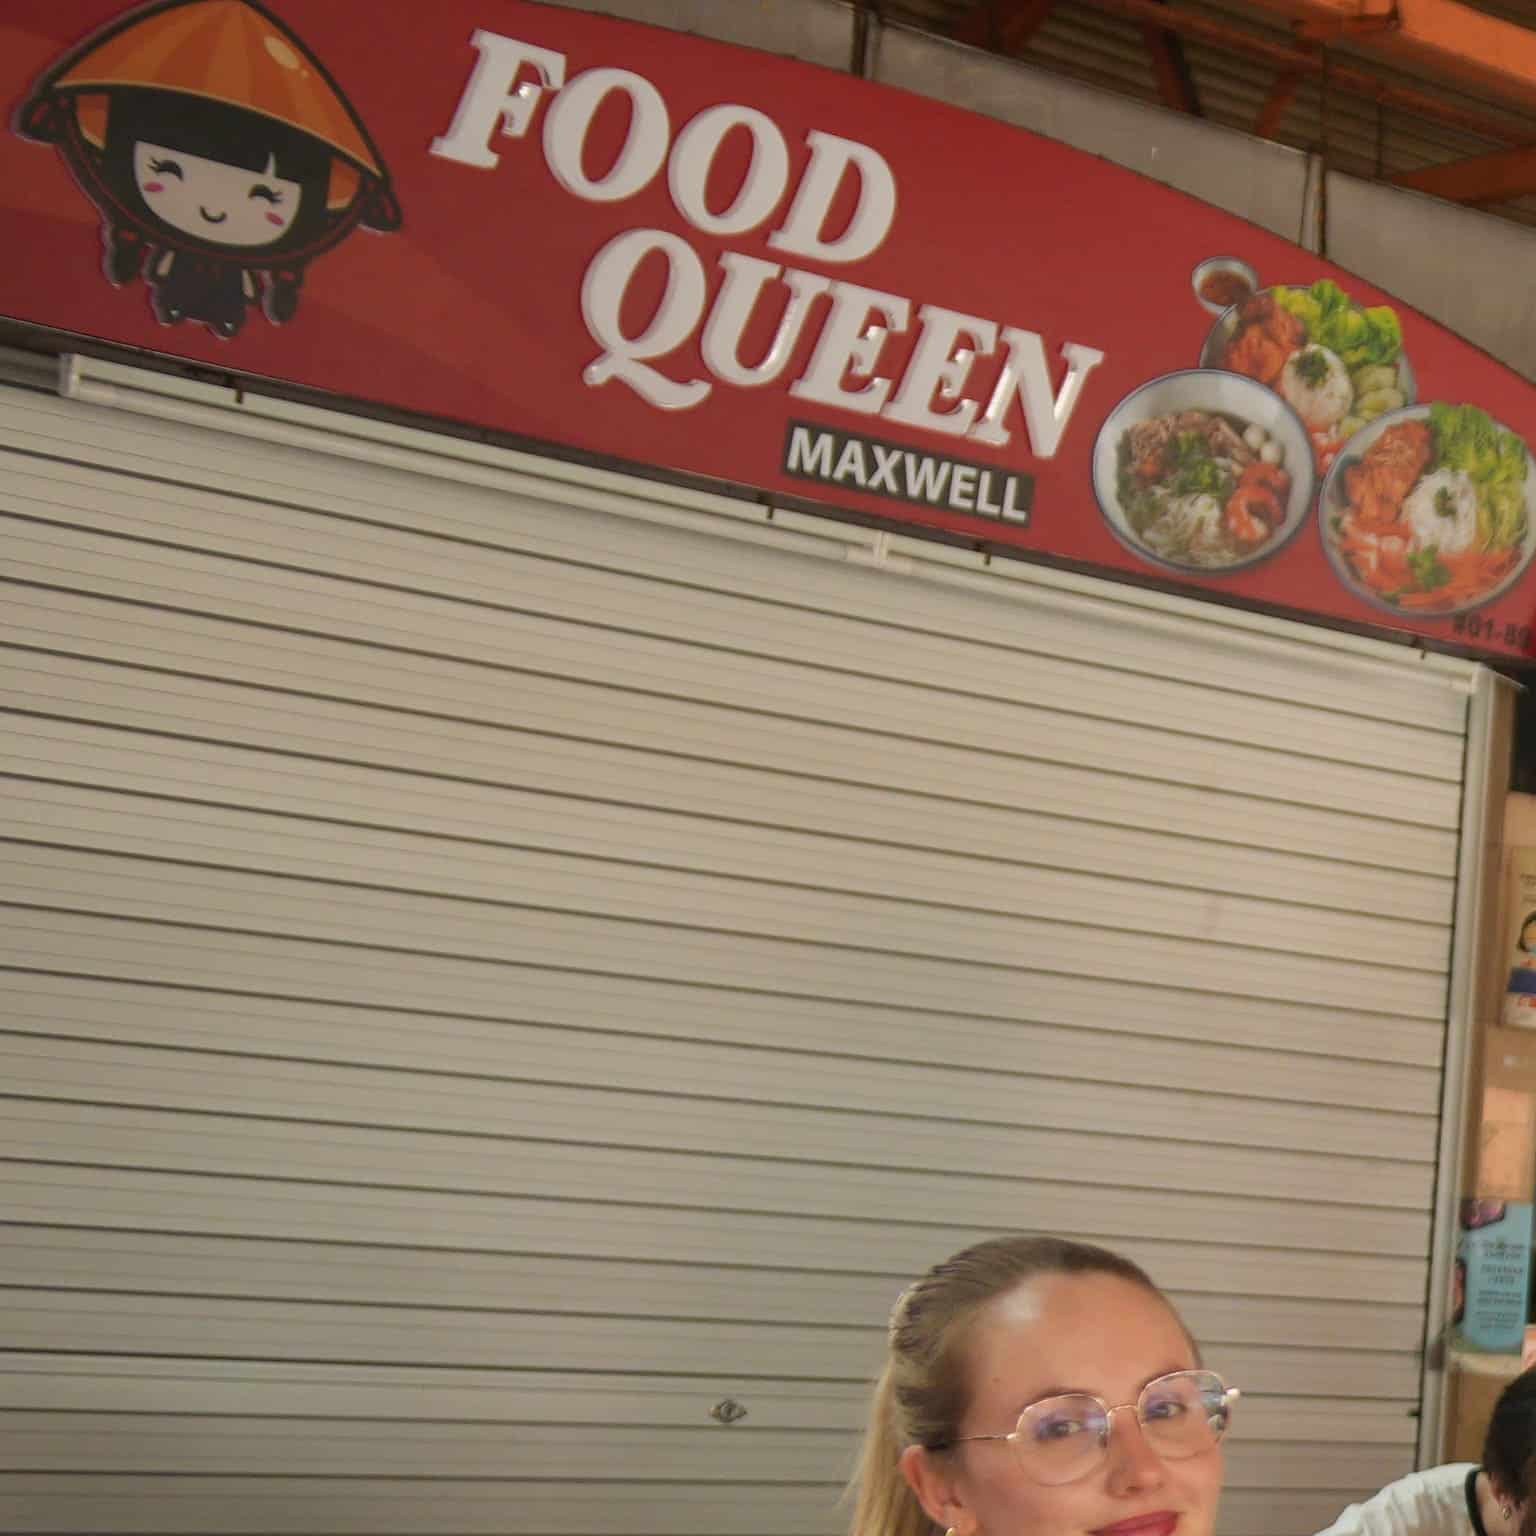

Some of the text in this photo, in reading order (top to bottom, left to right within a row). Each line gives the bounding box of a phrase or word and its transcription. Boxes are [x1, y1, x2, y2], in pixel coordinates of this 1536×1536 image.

[429, 28, 896, 265] FOOD
[581, 228, 1105, 462] QUEEN
[786, 424, 1029, 525] MAXWELL
